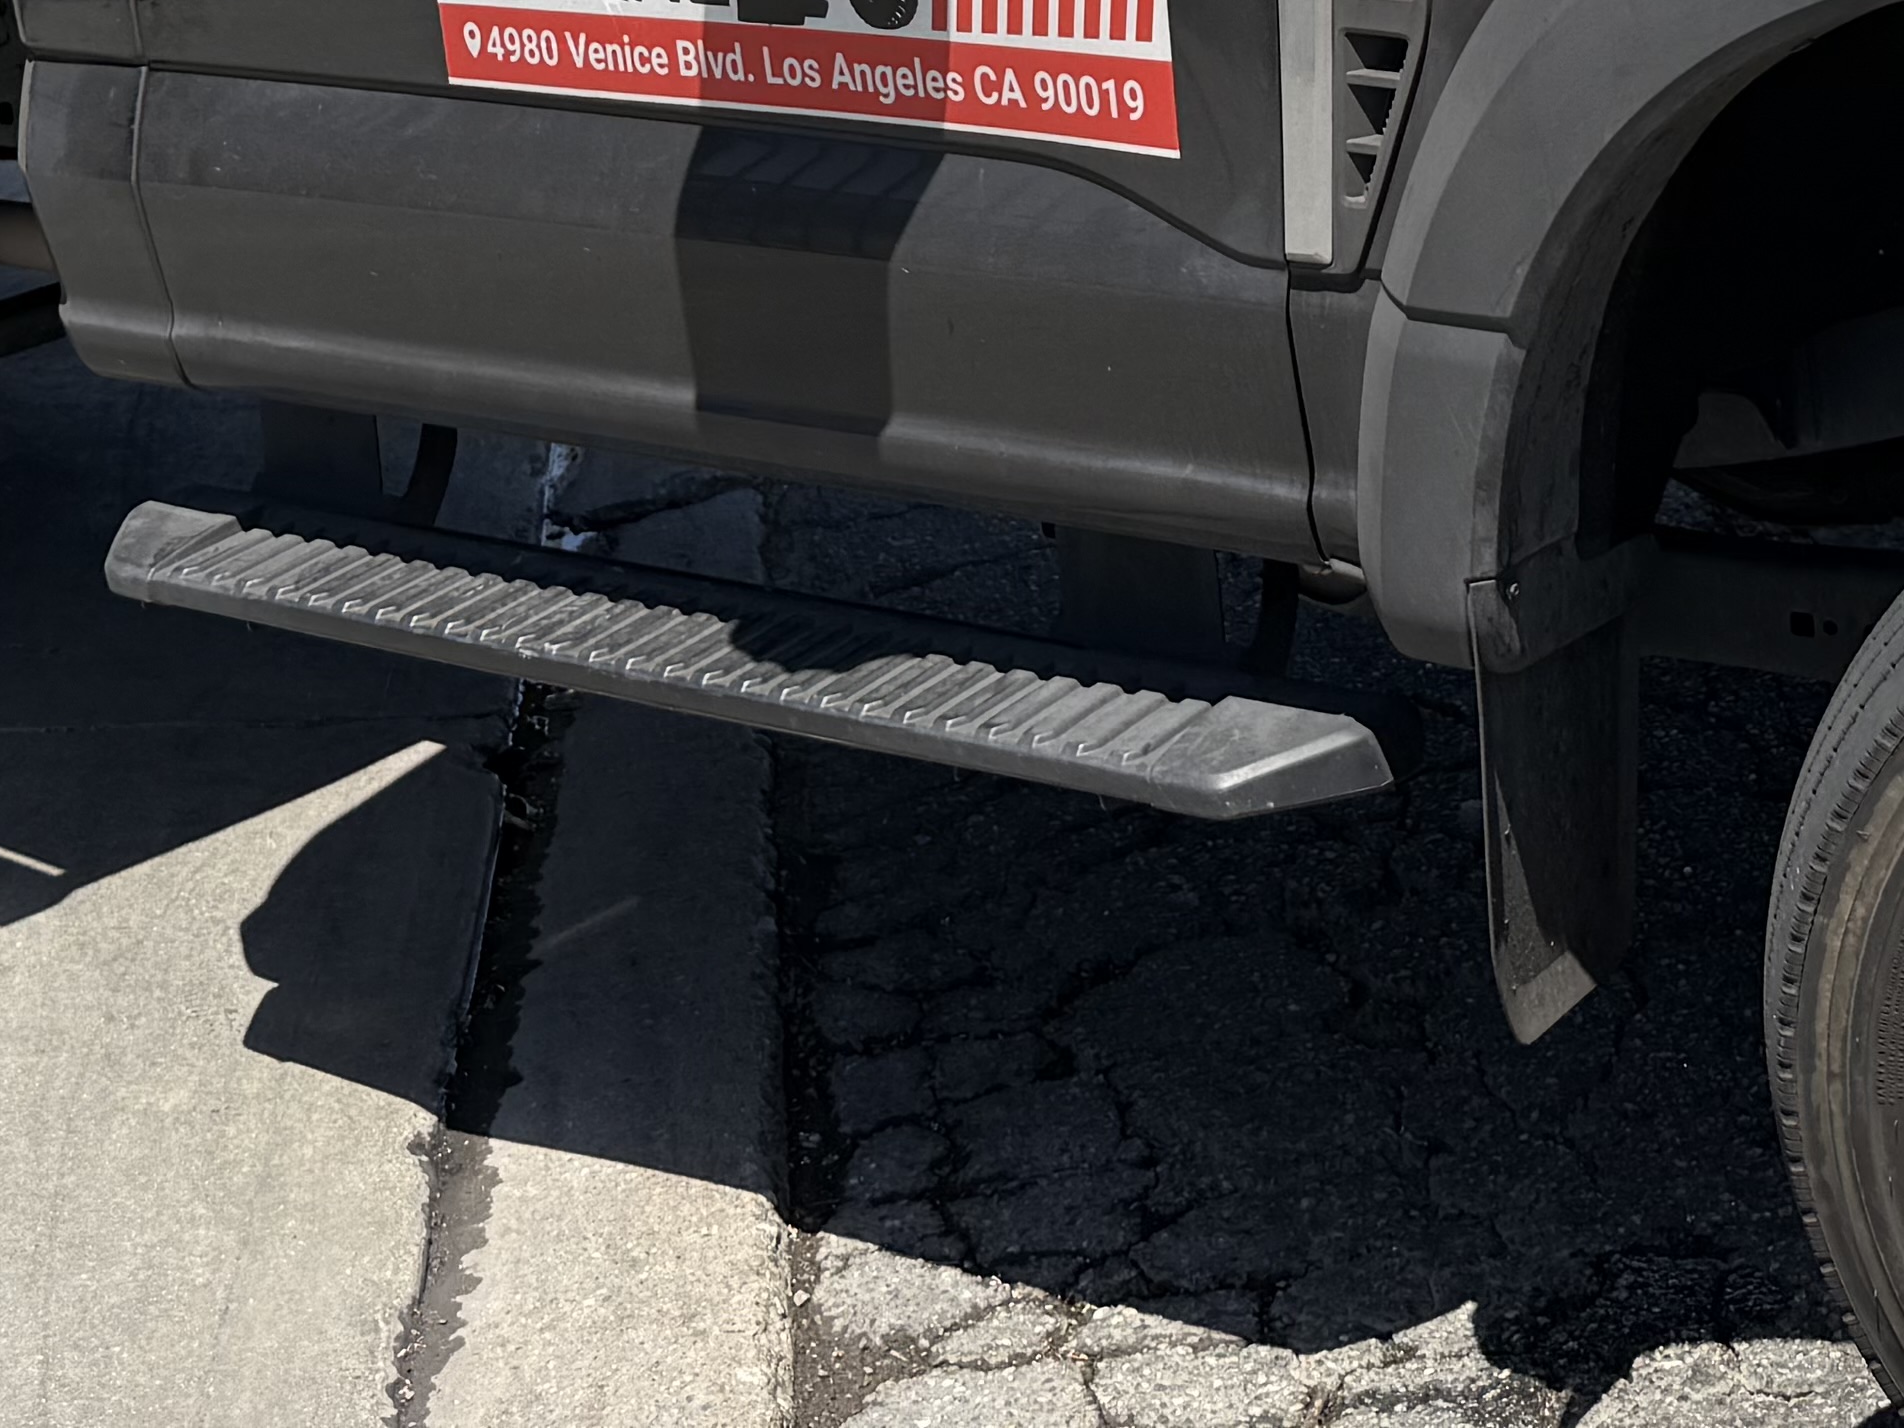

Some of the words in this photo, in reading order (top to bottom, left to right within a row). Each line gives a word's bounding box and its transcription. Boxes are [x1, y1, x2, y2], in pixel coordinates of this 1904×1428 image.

[487, 25, 559, 67] 4980
[564, 31, 670, 76] Venice
[676, 39, 755, 83] Blvd.
[763, 46, 822, 88] Los
[831, 52, 966, 105] Angeles
[973, 64, 1028, 109] CA
[1034, 70, 1145, 121] 90019
